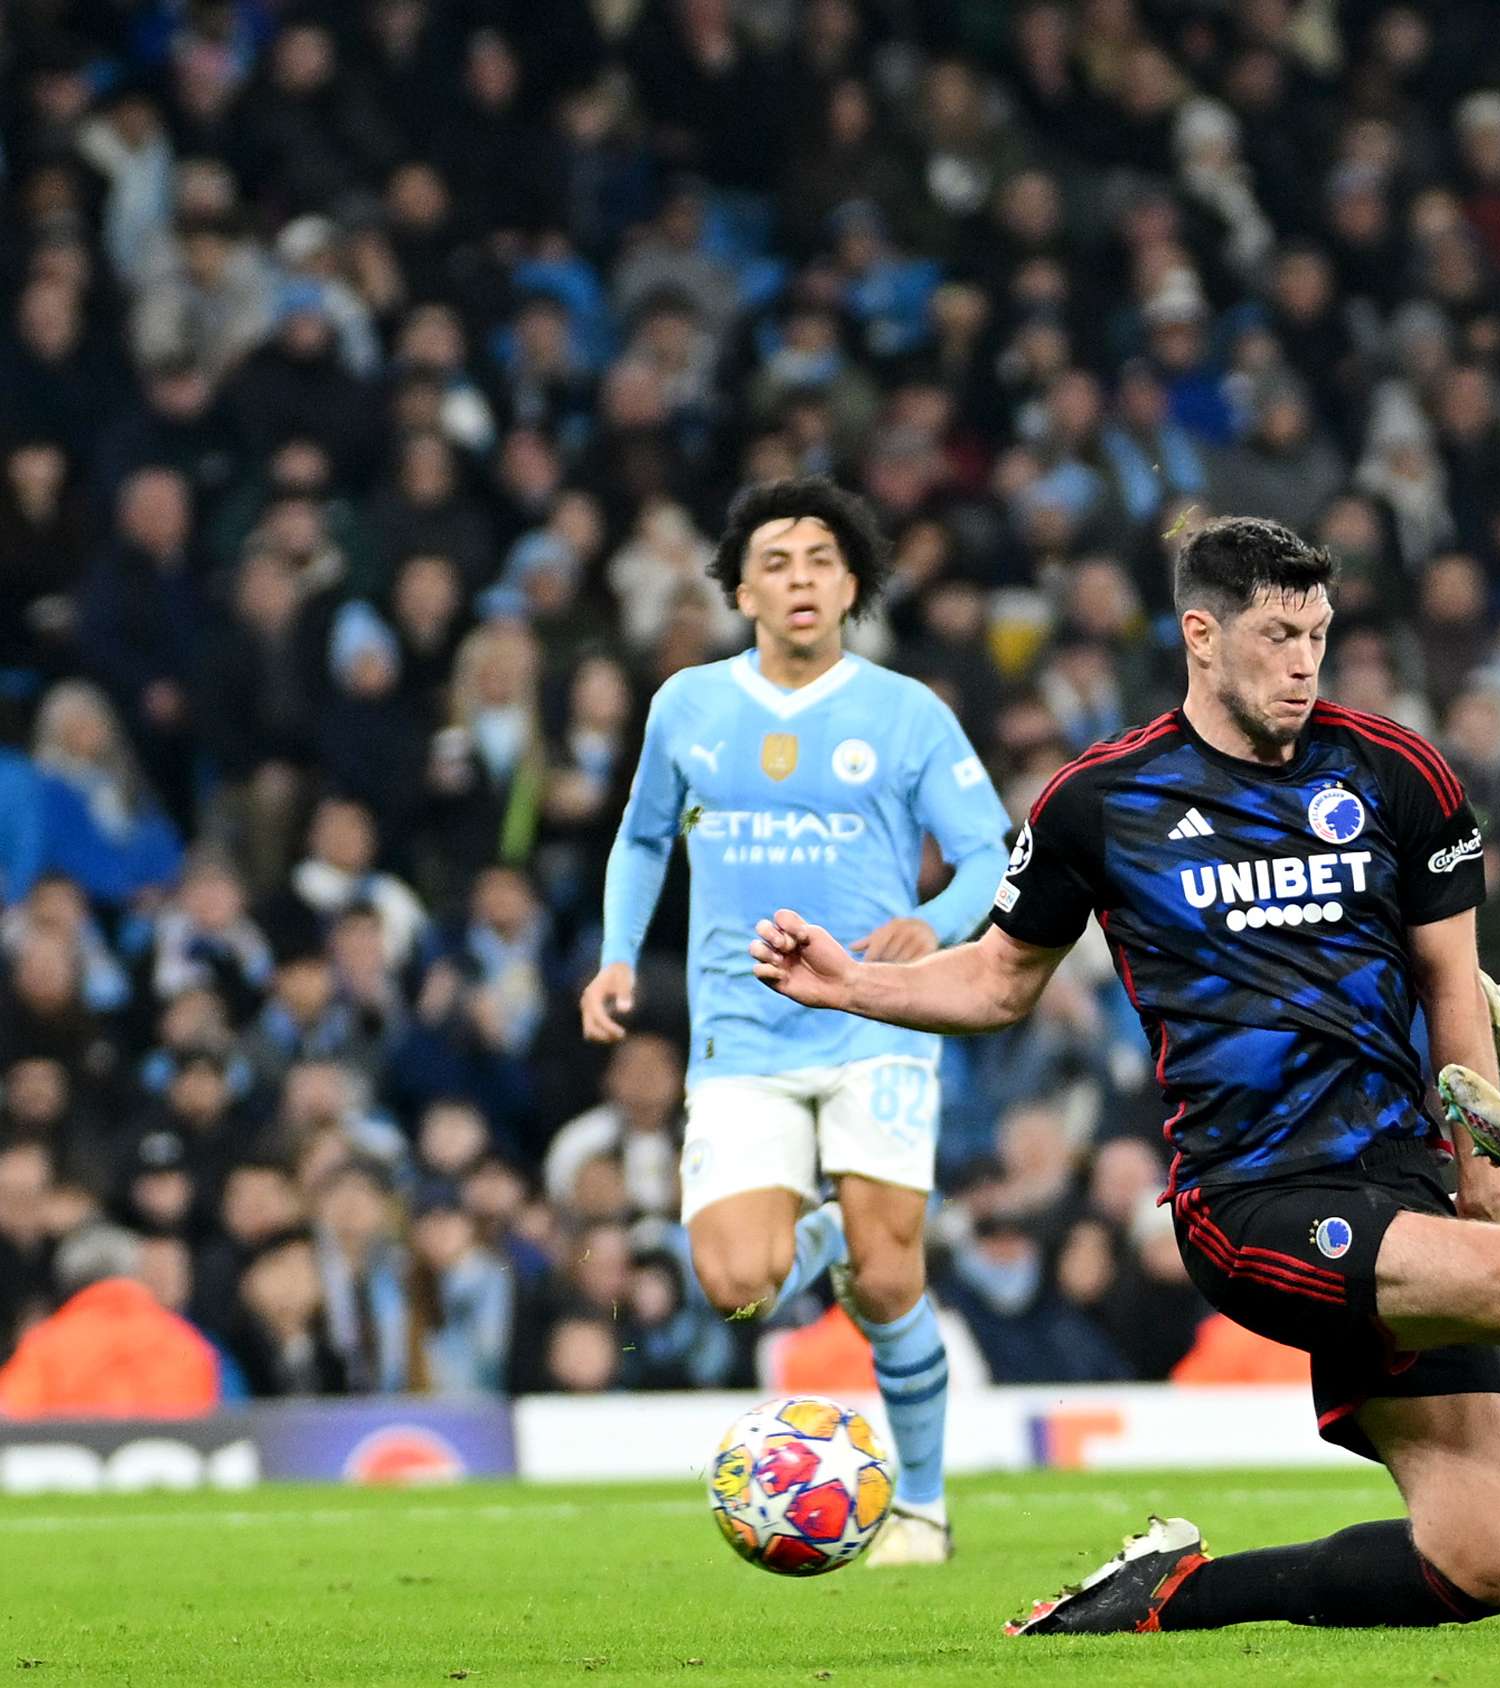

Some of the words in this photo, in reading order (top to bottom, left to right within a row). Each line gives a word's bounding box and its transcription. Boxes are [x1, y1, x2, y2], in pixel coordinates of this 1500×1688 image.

[698, 811, 866, 841] ETIHAD
[722, 844, 839, 865] AIRWAYS
[1180, 851, 1372, 907] UNIBET
[869, 1065, 931, 1128] 82
